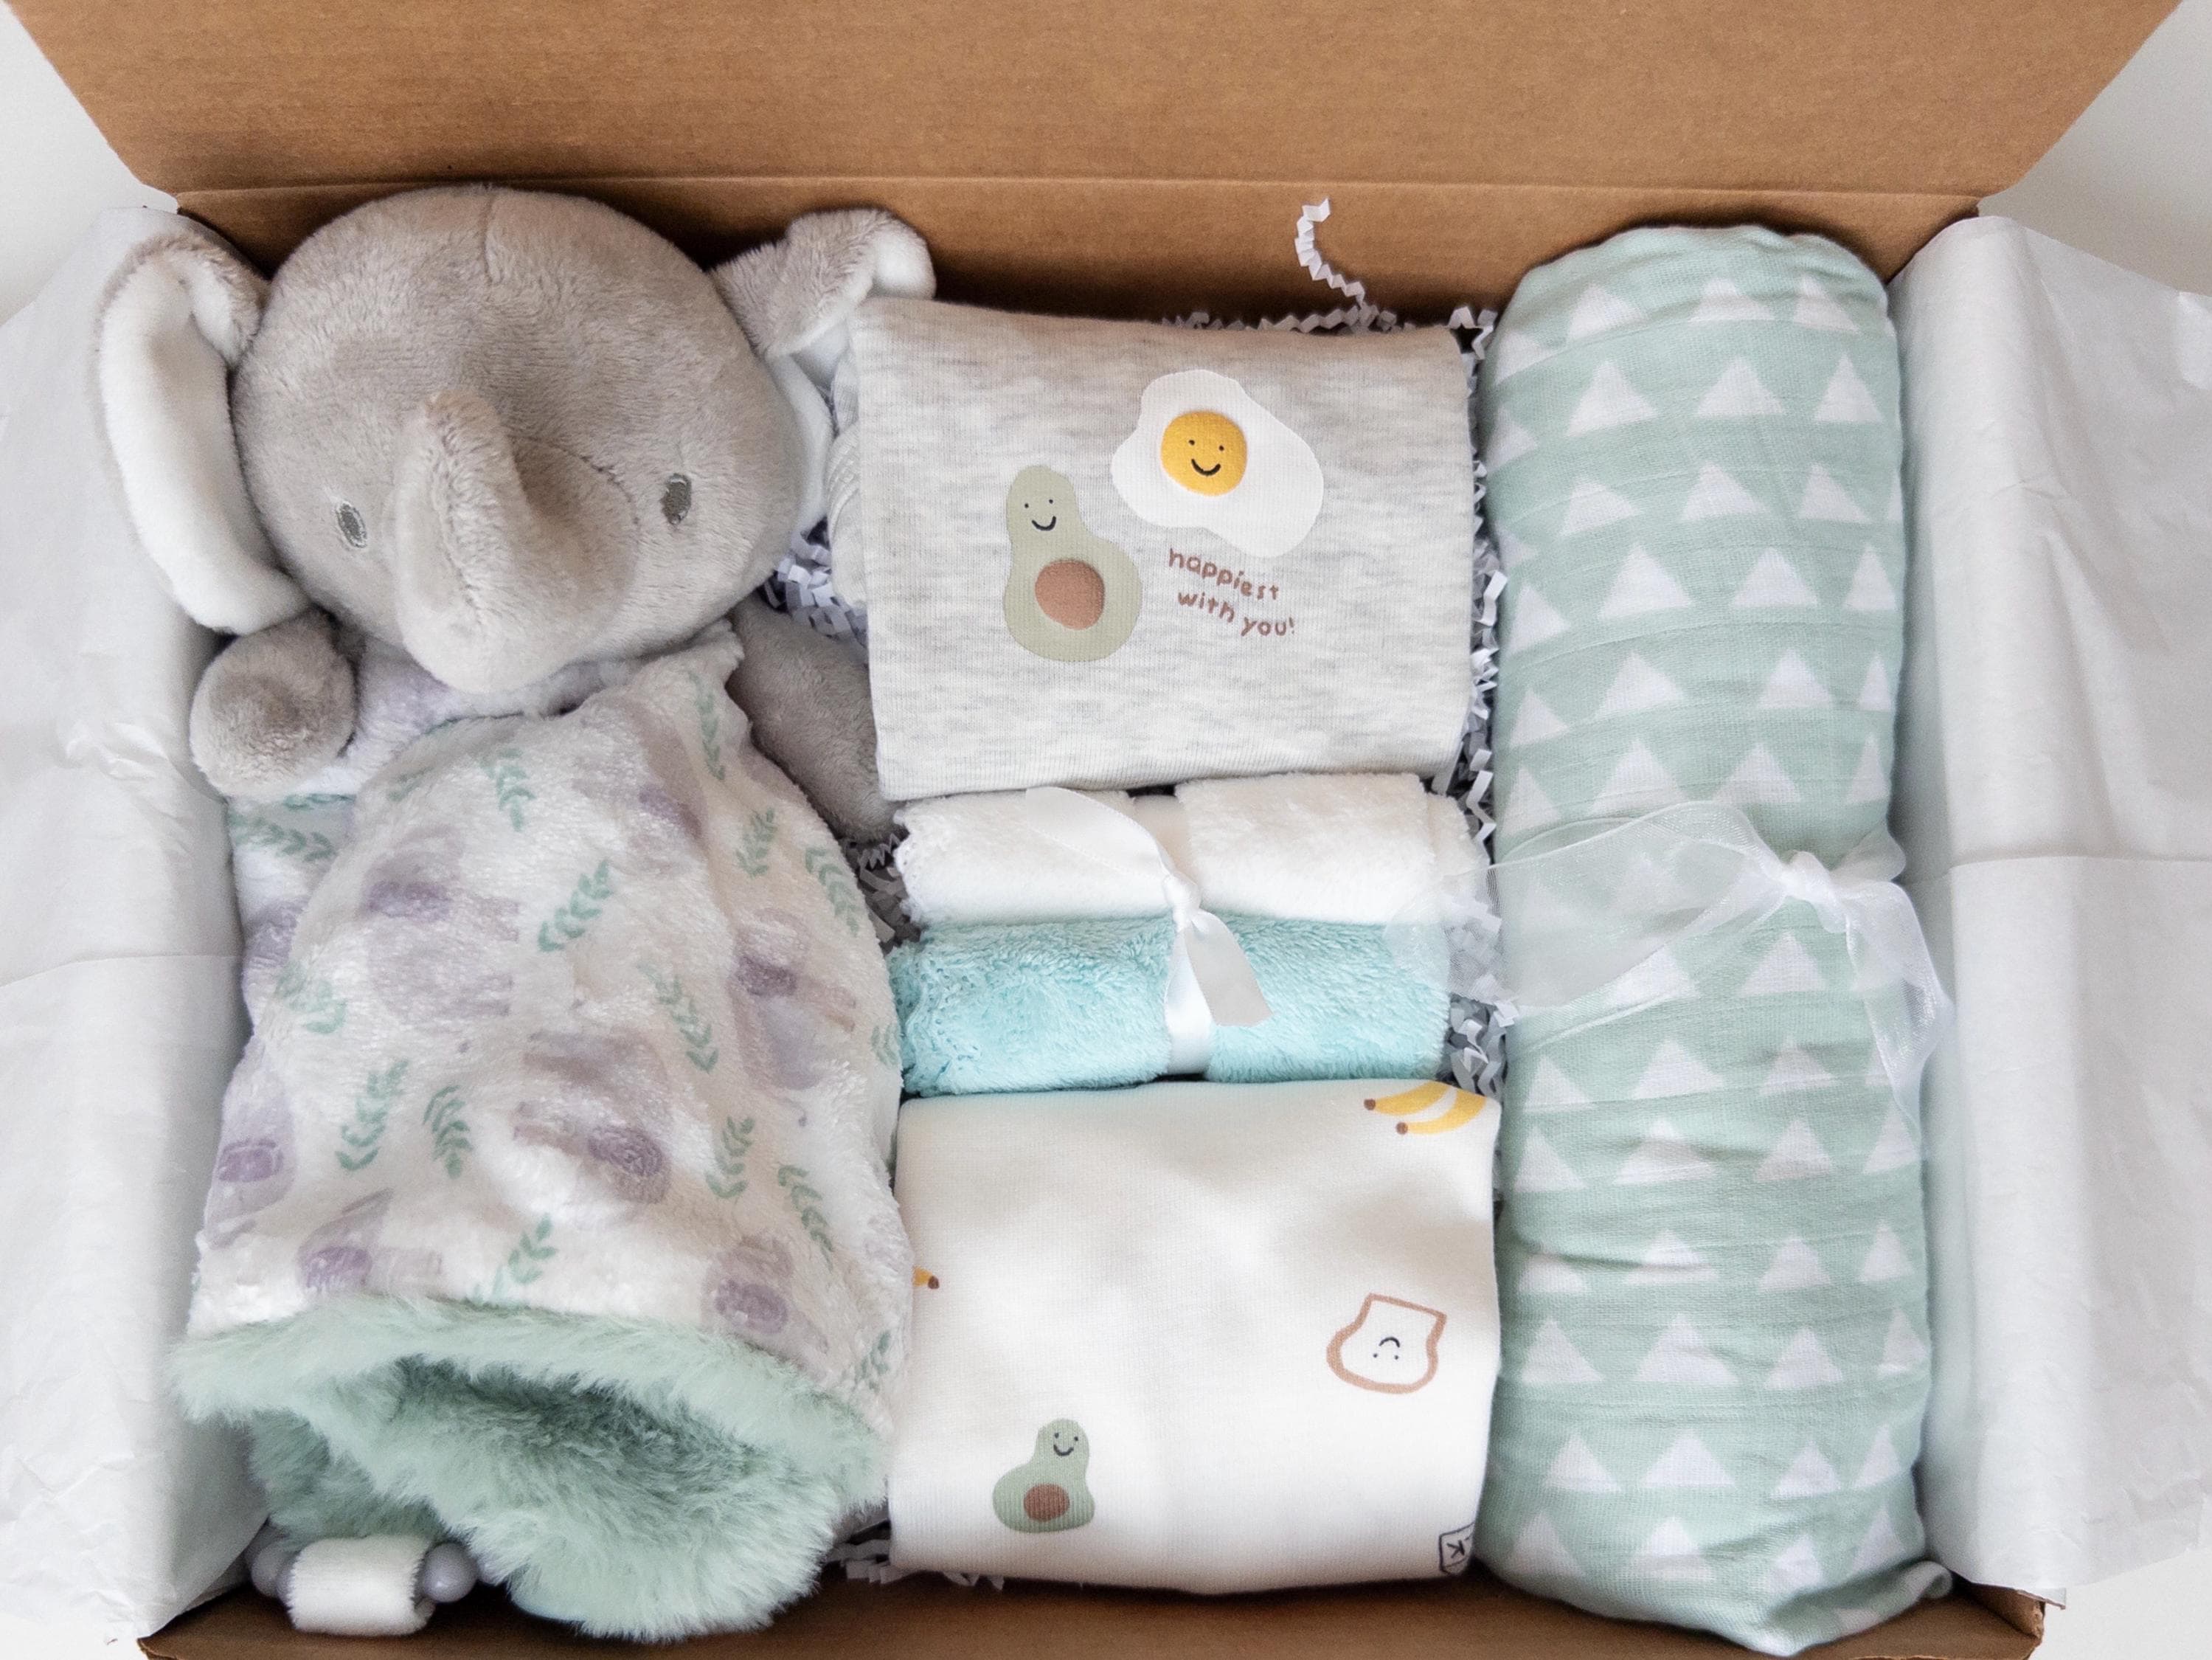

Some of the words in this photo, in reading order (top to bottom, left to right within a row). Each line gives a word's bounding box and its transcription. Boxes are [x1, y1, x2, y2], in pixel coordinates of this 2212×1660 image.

[1168, 547, 1279, 600] happiest
[1178, 592, 1235, 623] with
[1241, 617, 1294, 637] you!
